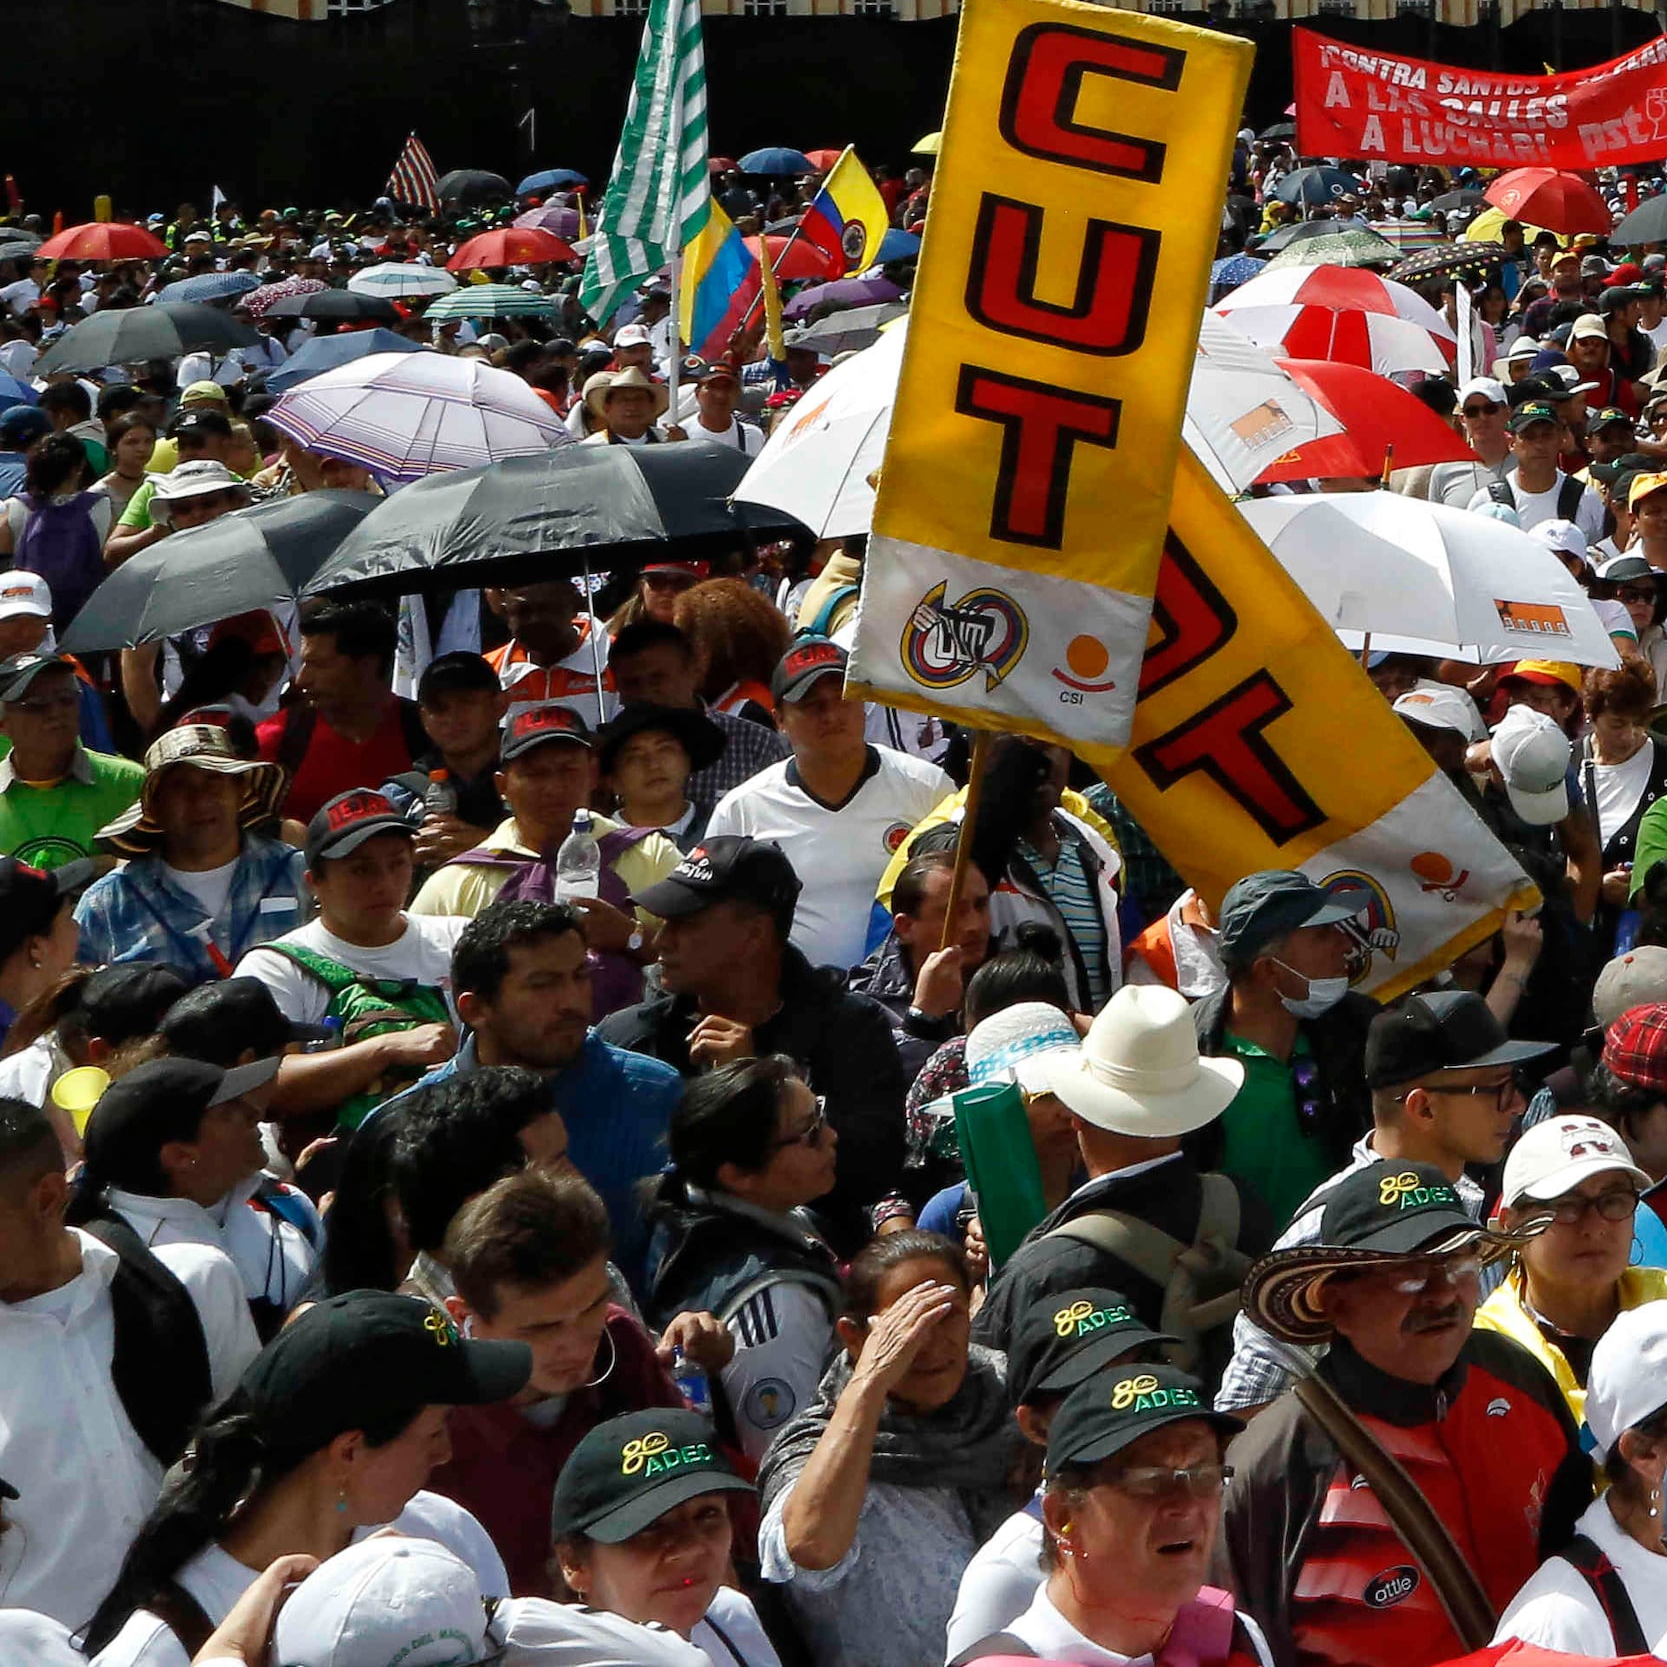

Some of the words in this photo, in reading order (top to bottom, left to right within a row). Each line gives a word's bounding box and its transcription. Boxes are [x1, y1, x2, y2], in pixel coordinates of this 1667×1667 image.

[1324, 71, 1351, 109] A
[1367, 83, 1430, 117] LAS
[1439, 94, 1569, 130] CALLES
[1360, 115, 1386, 153] A
[955, 22, 1188, 549] CUT
[1060, 691, 1084, 705] CSI
[1379, 1170, 1420, 1205] 80
[1054, 1300, 1093, 1337] 80
[1111, 1374, 1158, 1409] 80
[622, 1431, 669, 1475] 80
[645, 1442, 714, 1477] ADEC
[1374, 1574, 1415, 1602] attle
